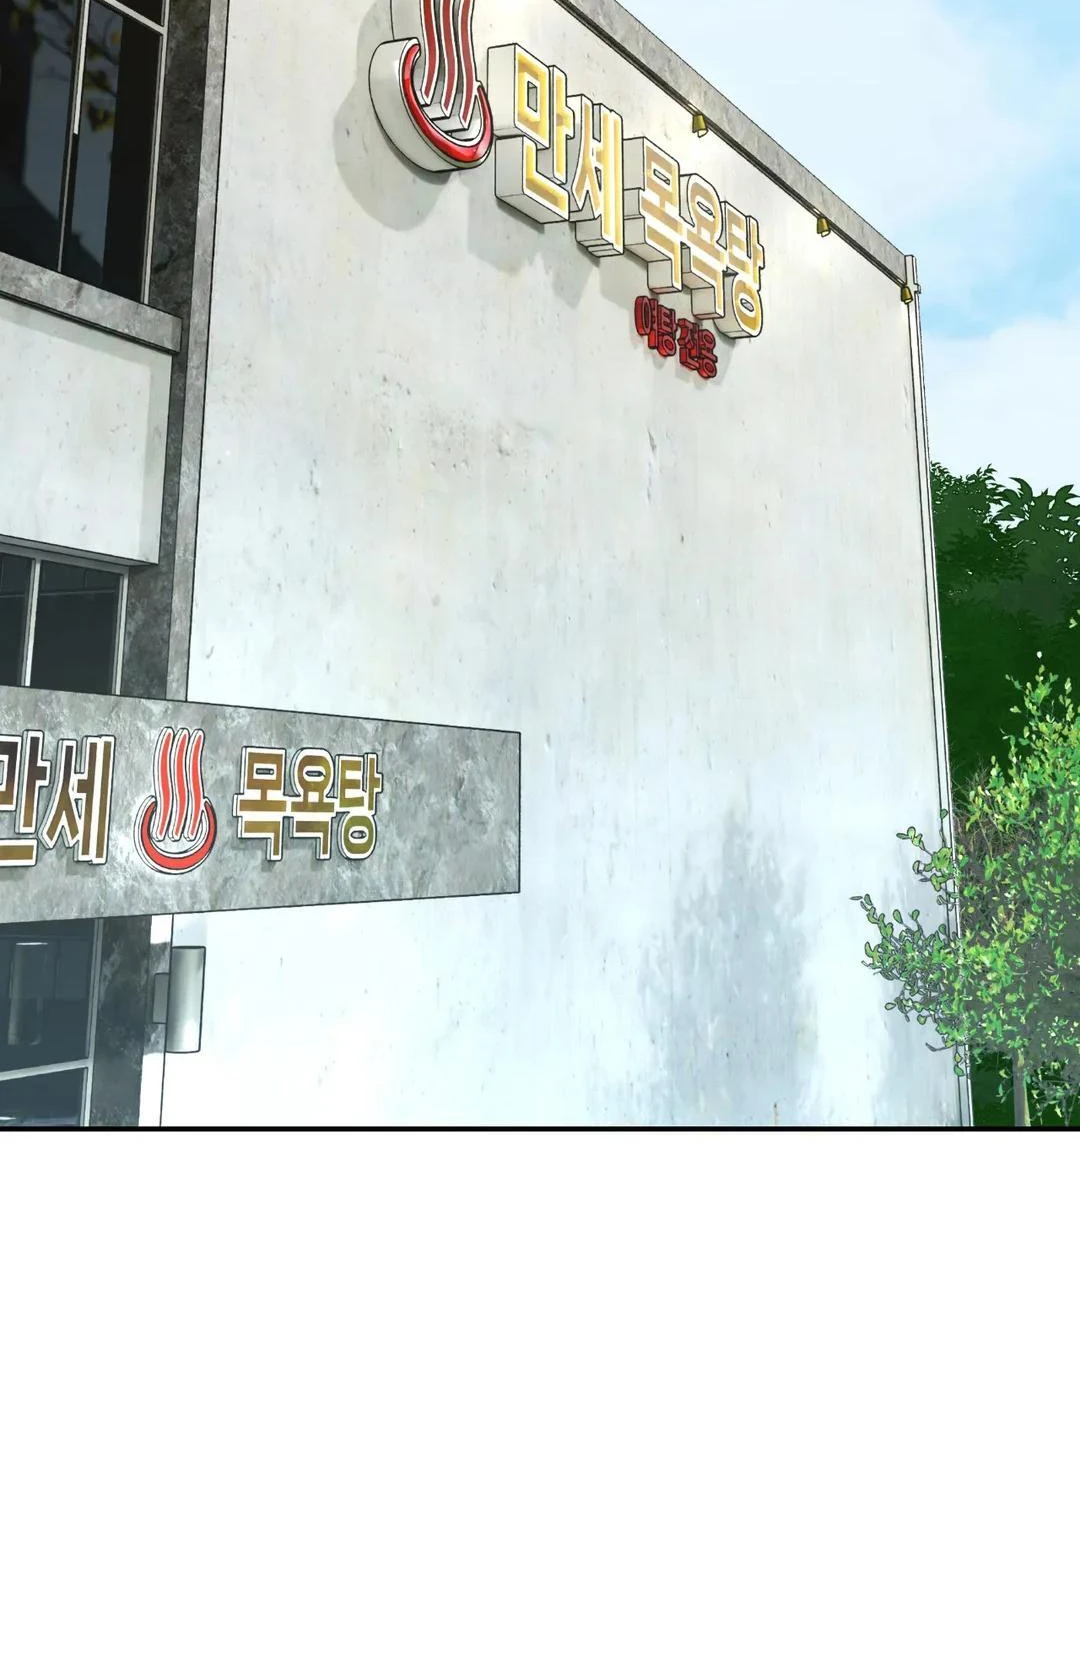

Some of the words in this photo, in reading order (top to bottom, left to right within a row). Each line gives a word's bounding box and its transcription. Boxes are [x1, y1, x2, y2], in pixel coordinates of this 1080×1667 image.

[489, 43, 625, 257] 만세
[625, 137, 765, 339] 목욕탕
[232, 746, 383, 861] 목욕탕
